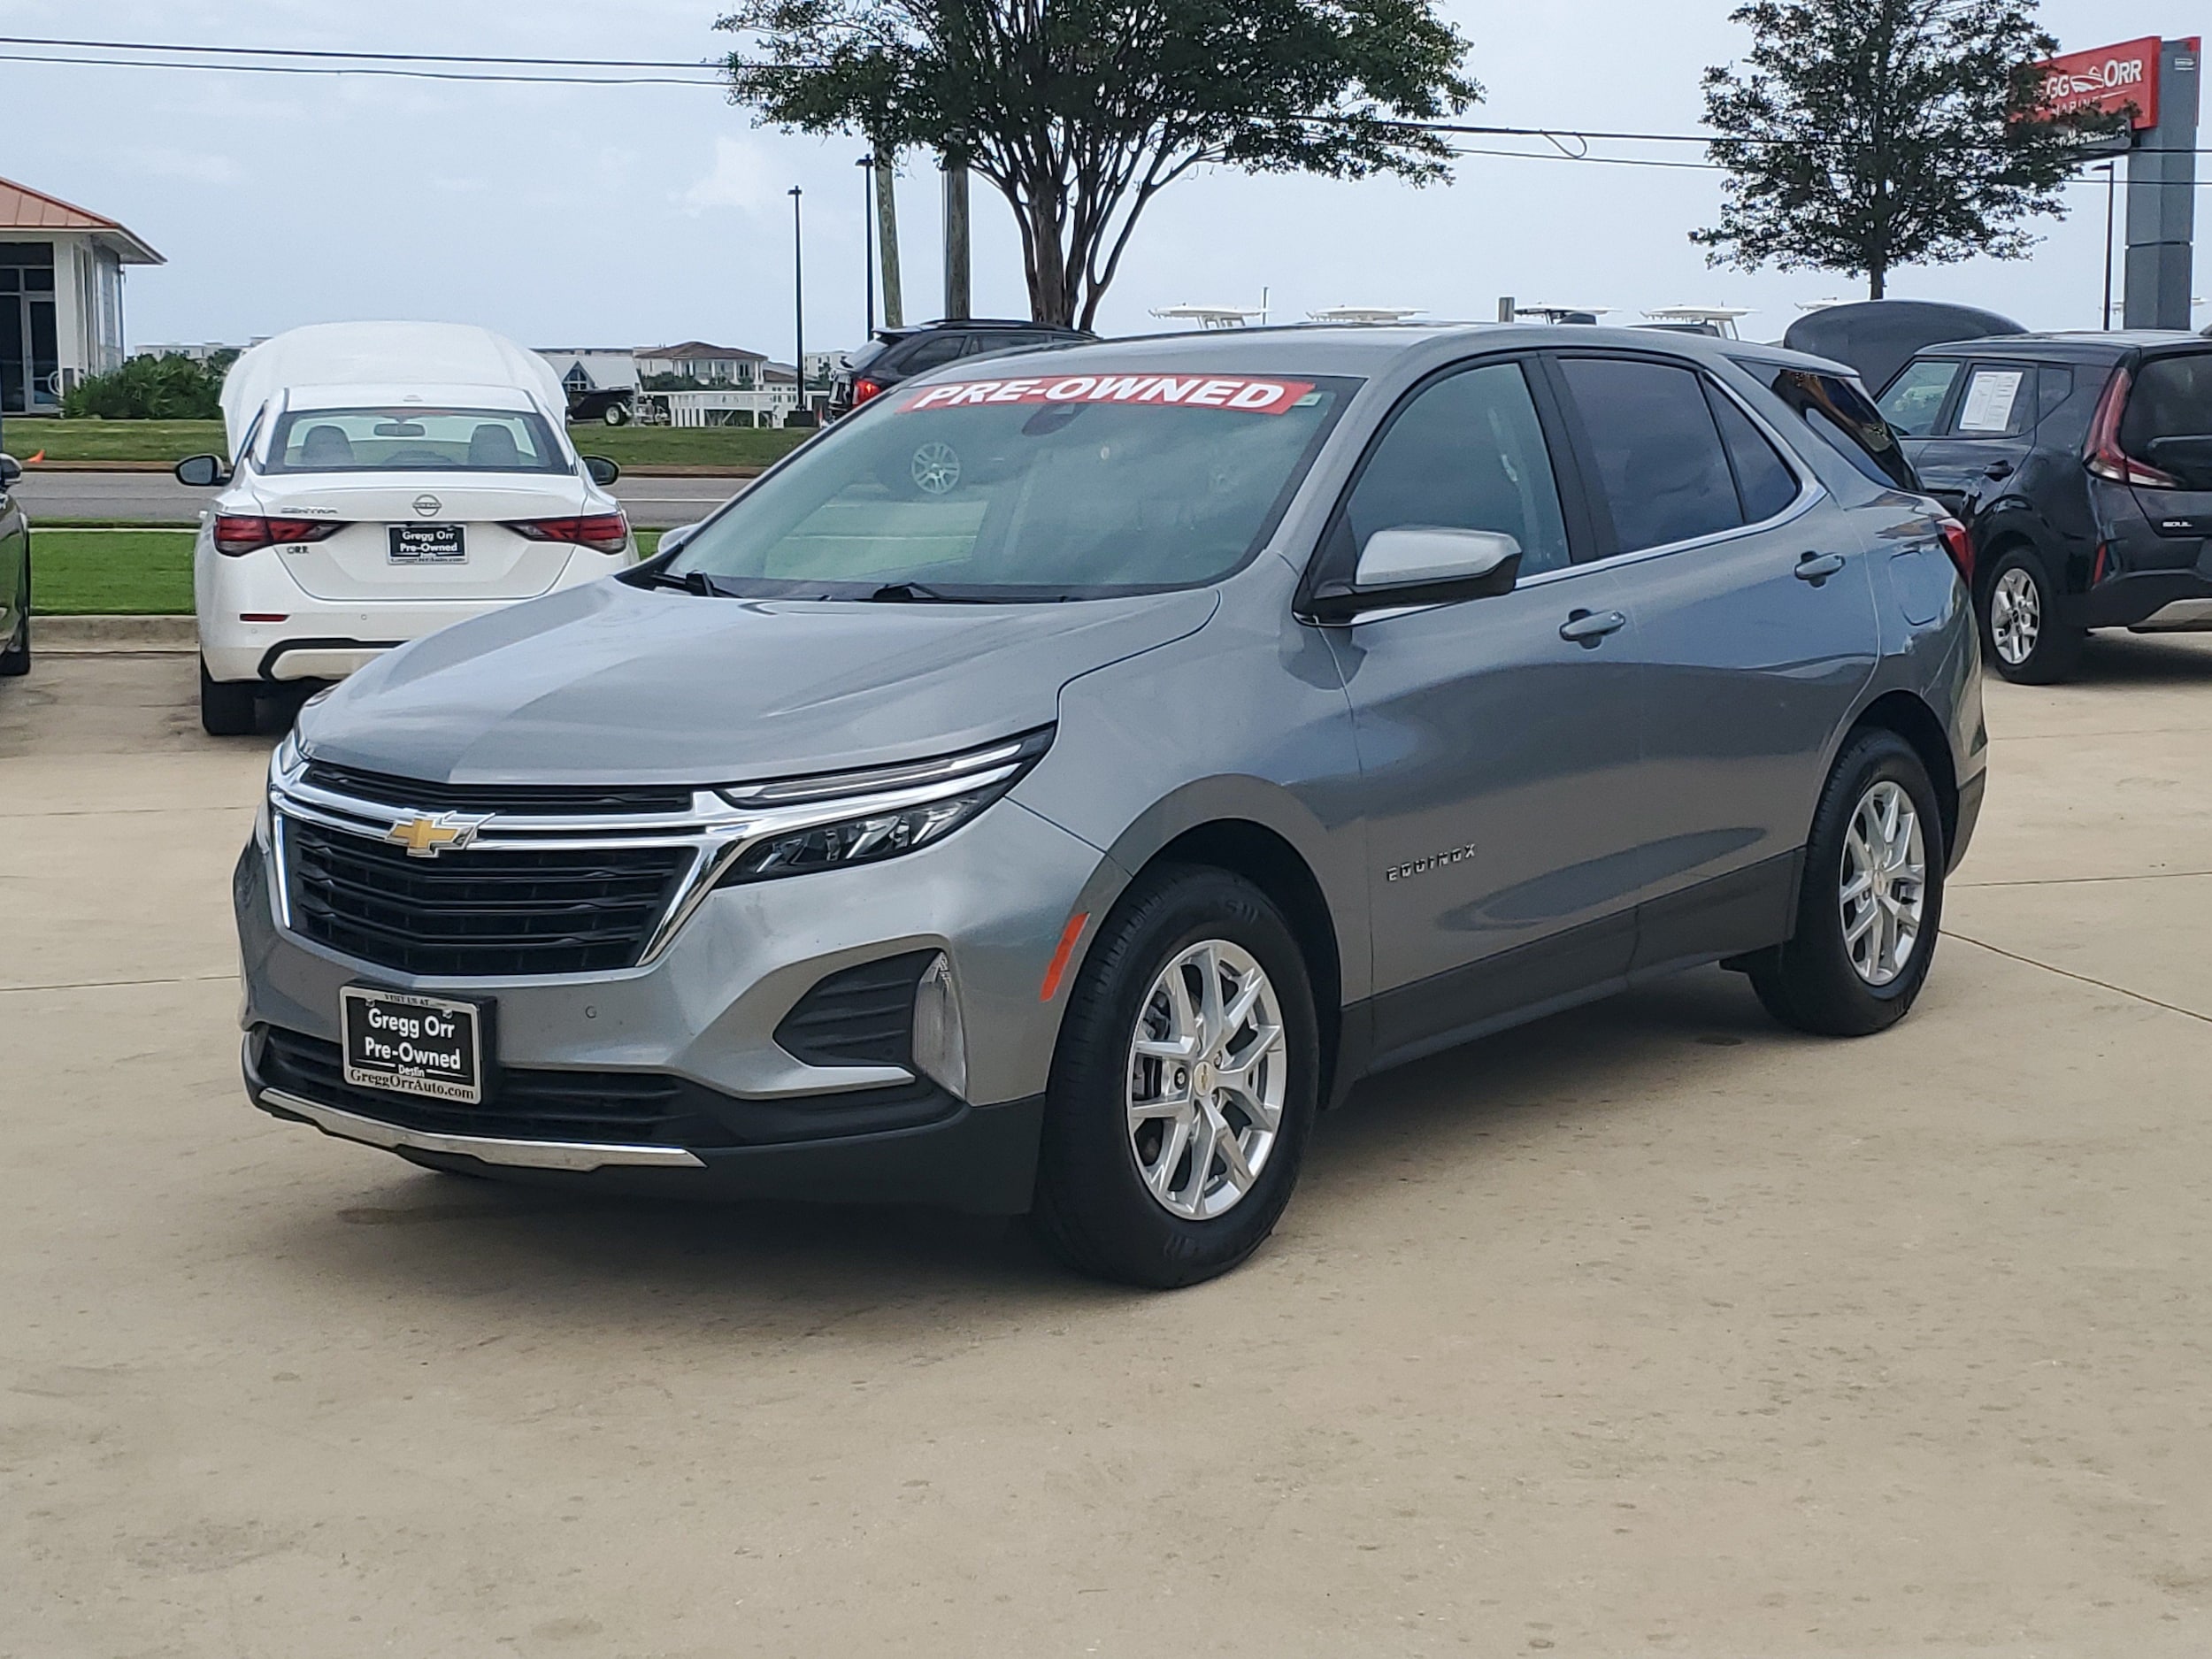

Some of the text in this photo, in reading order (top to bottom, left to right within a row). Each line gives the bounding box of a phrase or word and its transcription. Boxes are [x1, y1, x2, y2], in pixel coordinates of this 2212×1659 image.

[2103, 59, 2143, 88] ORR
[912, 377, 1285, 410] PRE-OWNED
[399, 542, 458, 552] Pre-Owned
[402, 531, 455, 541] Gregg Orr
[1386, 843, 1476, 881] EQUINOX
[368, 1008, 455, 1039] Gregg Orr
[365, 1036, 461, 1070] Pre-Owned
[350, 1069, 474, 1100] GreggOrrAuto.com
